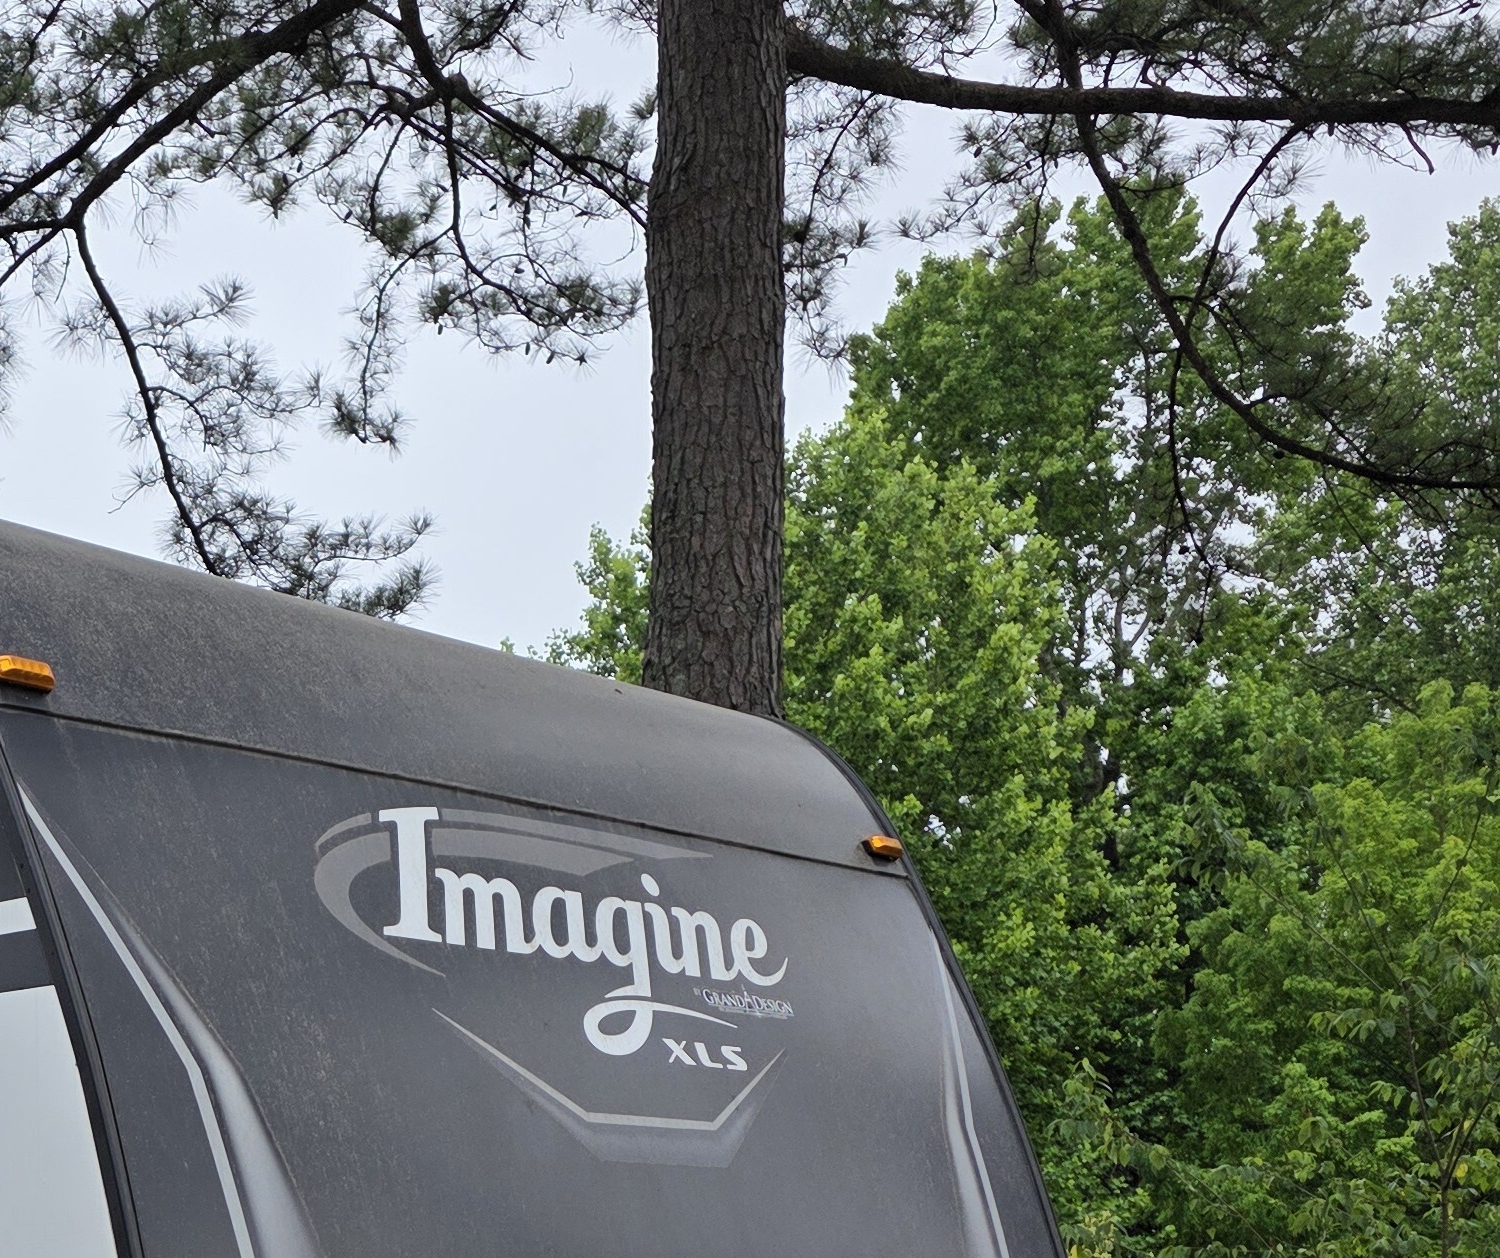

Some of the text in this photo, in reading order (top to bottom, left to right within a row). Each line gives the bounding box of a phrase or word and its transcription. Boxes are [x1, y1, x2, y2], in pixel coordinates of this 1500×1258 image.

[378, 806, 789, 1056] Imagine
[703, 988, 746, 1009] GRAND
[753, 995, 793, 1016] DESIGN
[661, 1038, 748, 1071] XLS
